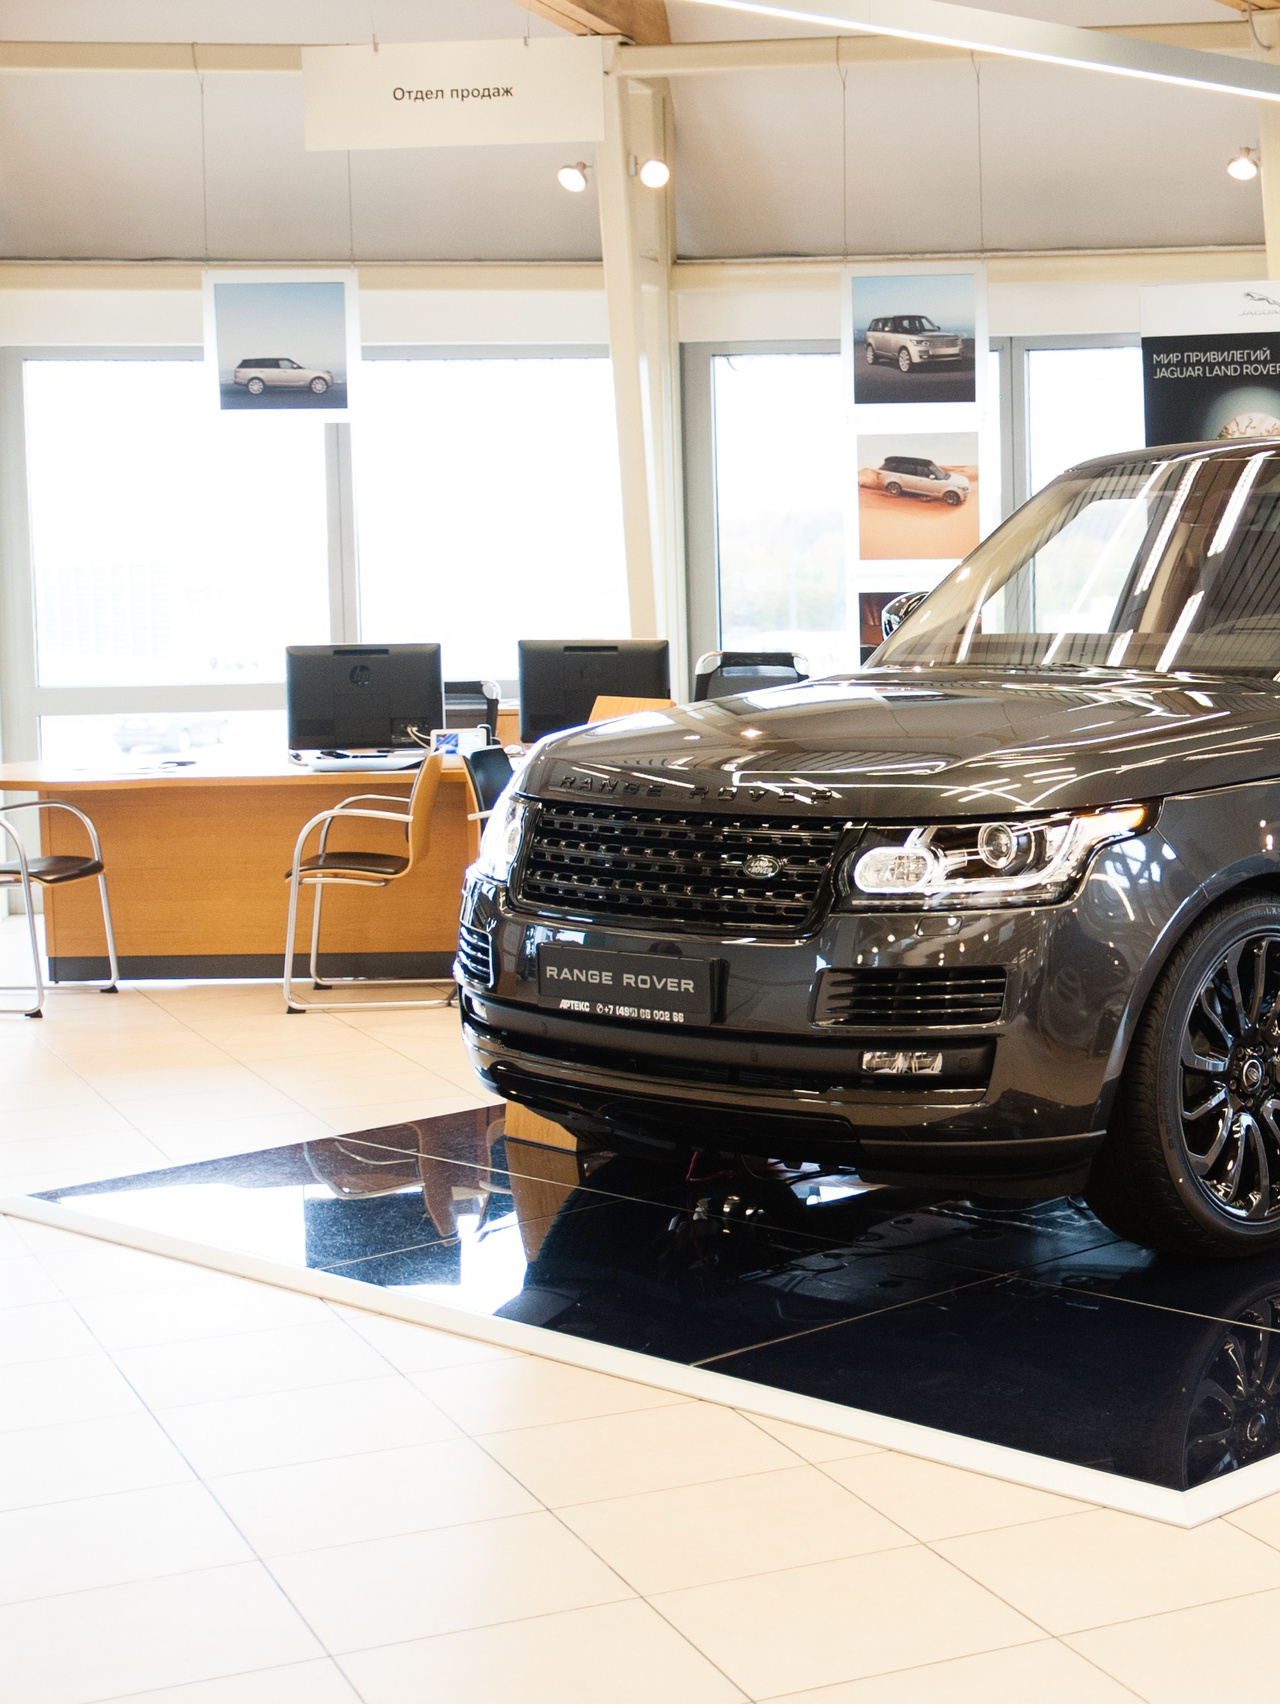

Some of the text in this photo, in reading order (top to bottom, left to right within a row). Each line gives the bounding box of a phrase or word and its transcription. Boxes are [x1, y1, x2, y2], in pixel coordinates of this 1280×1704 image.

[393, 86, 513, 102] Отдел продаж
[1153, 347, 1270, 364] МИР ПРИВИЛЕГИЙ
[1153, 366, 1203, 379] JAGUAR
[1206, 364, 1241, 377] LAND
[560, 775, 665, 797] RANGE
[546, 966, 695, 993] RANGE ROVER
[559, 999, 590, 1012] АРТЕКС
[604, 1004, 614, 1015] +7
[653, 1010, 670, 1021] 002
